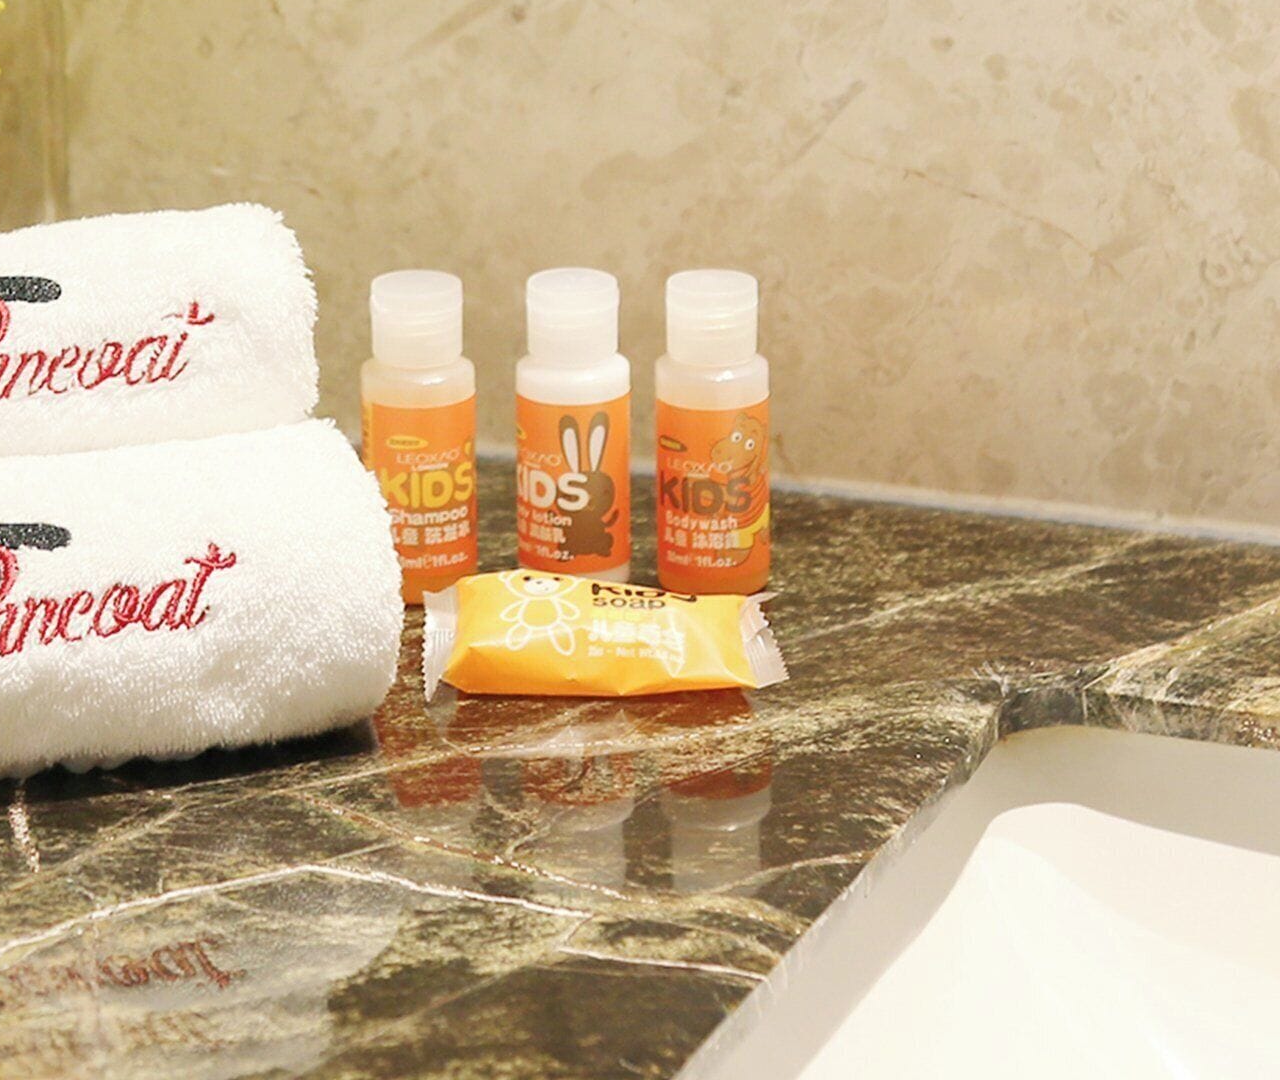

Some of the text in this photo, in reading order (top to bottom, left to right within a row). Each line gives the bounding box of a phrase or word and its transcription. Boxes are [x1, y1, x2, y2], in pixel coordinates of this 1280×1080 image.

[379, 461, 474, 509] KIDS
[660, 471, 753, 515] KIDS
[592, 596, 667, 610] soap
